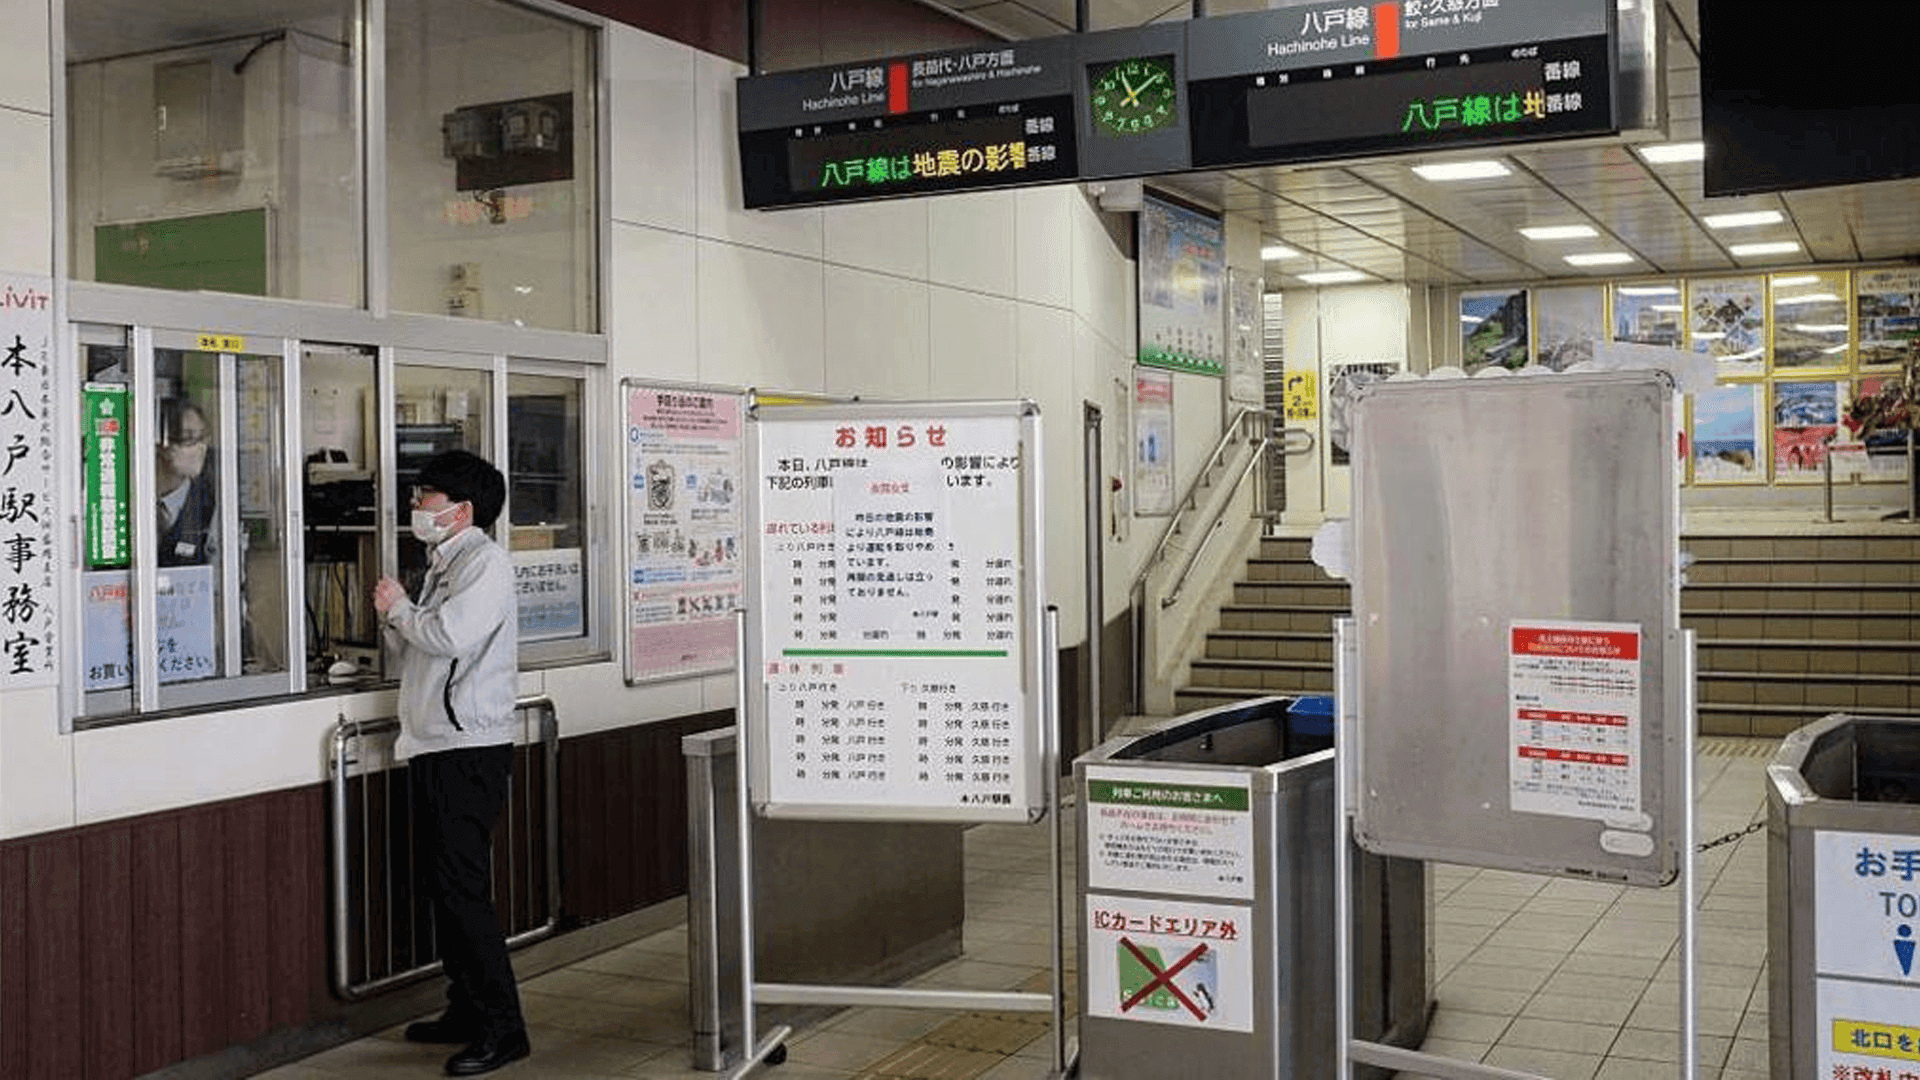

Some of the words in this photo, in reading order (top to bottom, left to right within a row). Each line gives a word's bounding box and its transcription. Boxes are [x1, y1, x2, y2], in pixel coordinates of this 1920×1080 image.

[1300, 8, 1370, 36] 八戸線
[1267, 37, 1338, 57] Hachinohe
[1341, 34, 1370, 48] Line
[829, 67, 885, 92] 八戸線
[1544, 60, 1580, 81] 番線
[802, 94, 859, 112] Hachinohe
[1402, 89, 1546, 132] 八戸線は地
[1546, 93, 1582, 113] 番線
[821, 142, 1026, 187] 八戸線は地震の影響
[835, 425, 947, 449] お知らせ
[778, 458, 868, 472] 本日、八戸線は
[946, 473, 992, 488] います。
[0, 334, 39, 675] 本八戸駅事務室
[846, 557, 890, 567] ています。
[847, 587, 910, 598] ておりません。
[1855, 847, 1920, 881] お手
[1879, 891, 1920, 917] TO
[1094, 910, 1238, 940] ICカードエリア外
[1850, 1029, 1920, 1053] 北口を
